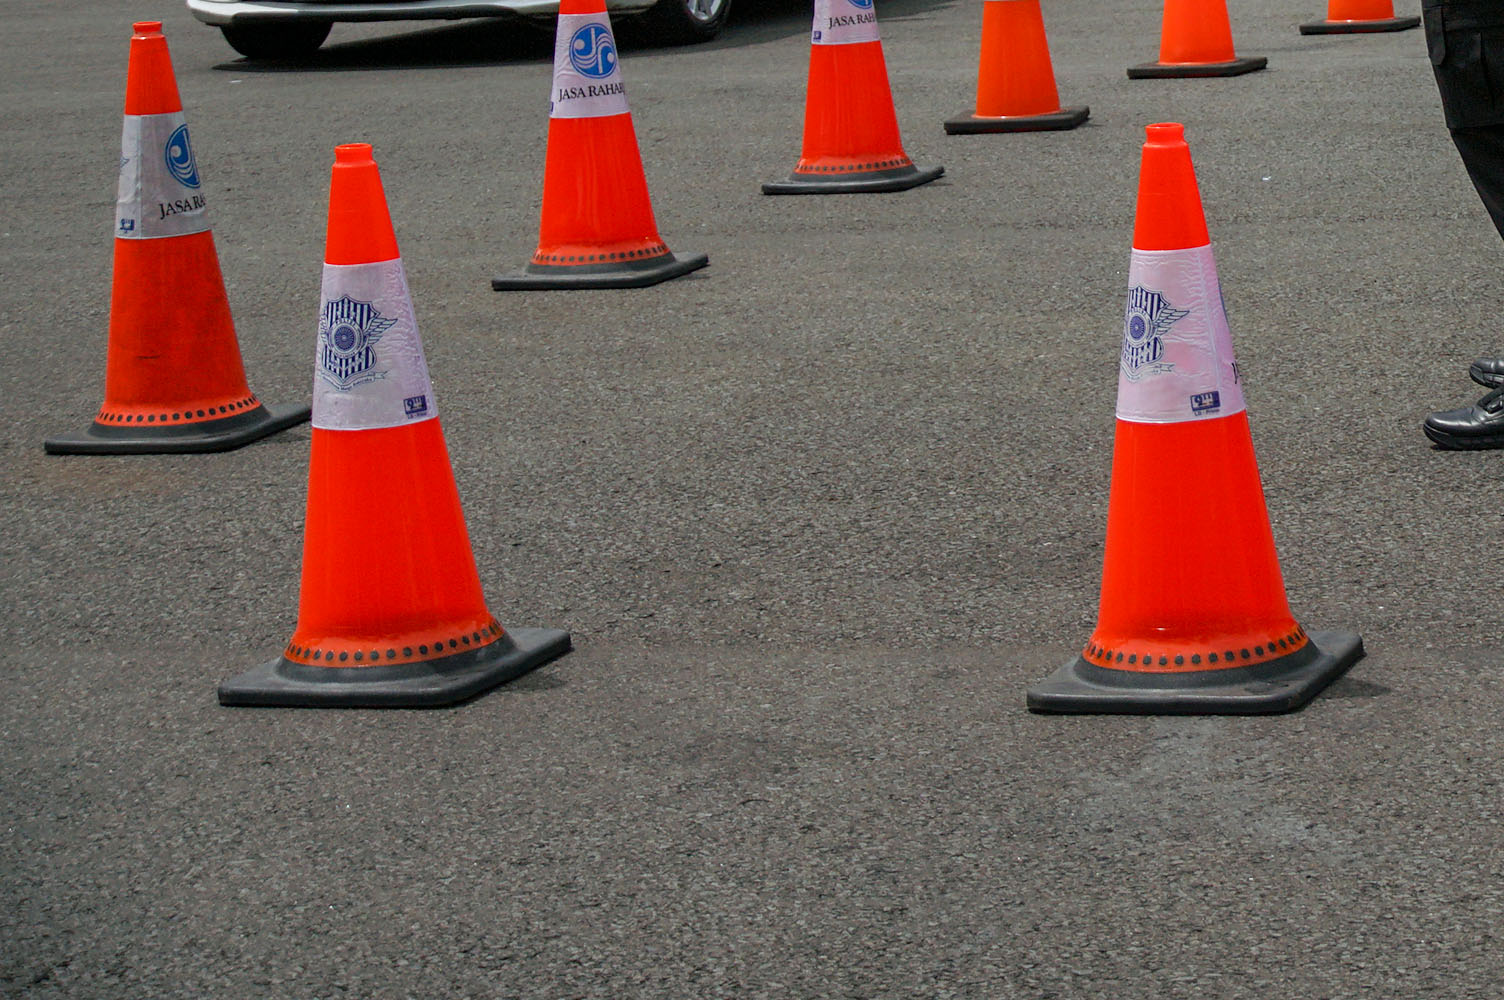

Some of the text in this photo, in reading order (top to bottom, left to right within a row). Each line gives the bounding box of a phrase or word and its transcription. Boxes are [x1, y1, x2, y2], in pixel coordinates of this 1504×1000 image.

[829, 15, 855, 30] JASA
[558, 86, 586, 102] JASA
[159, 199, 192, 220] JASA
